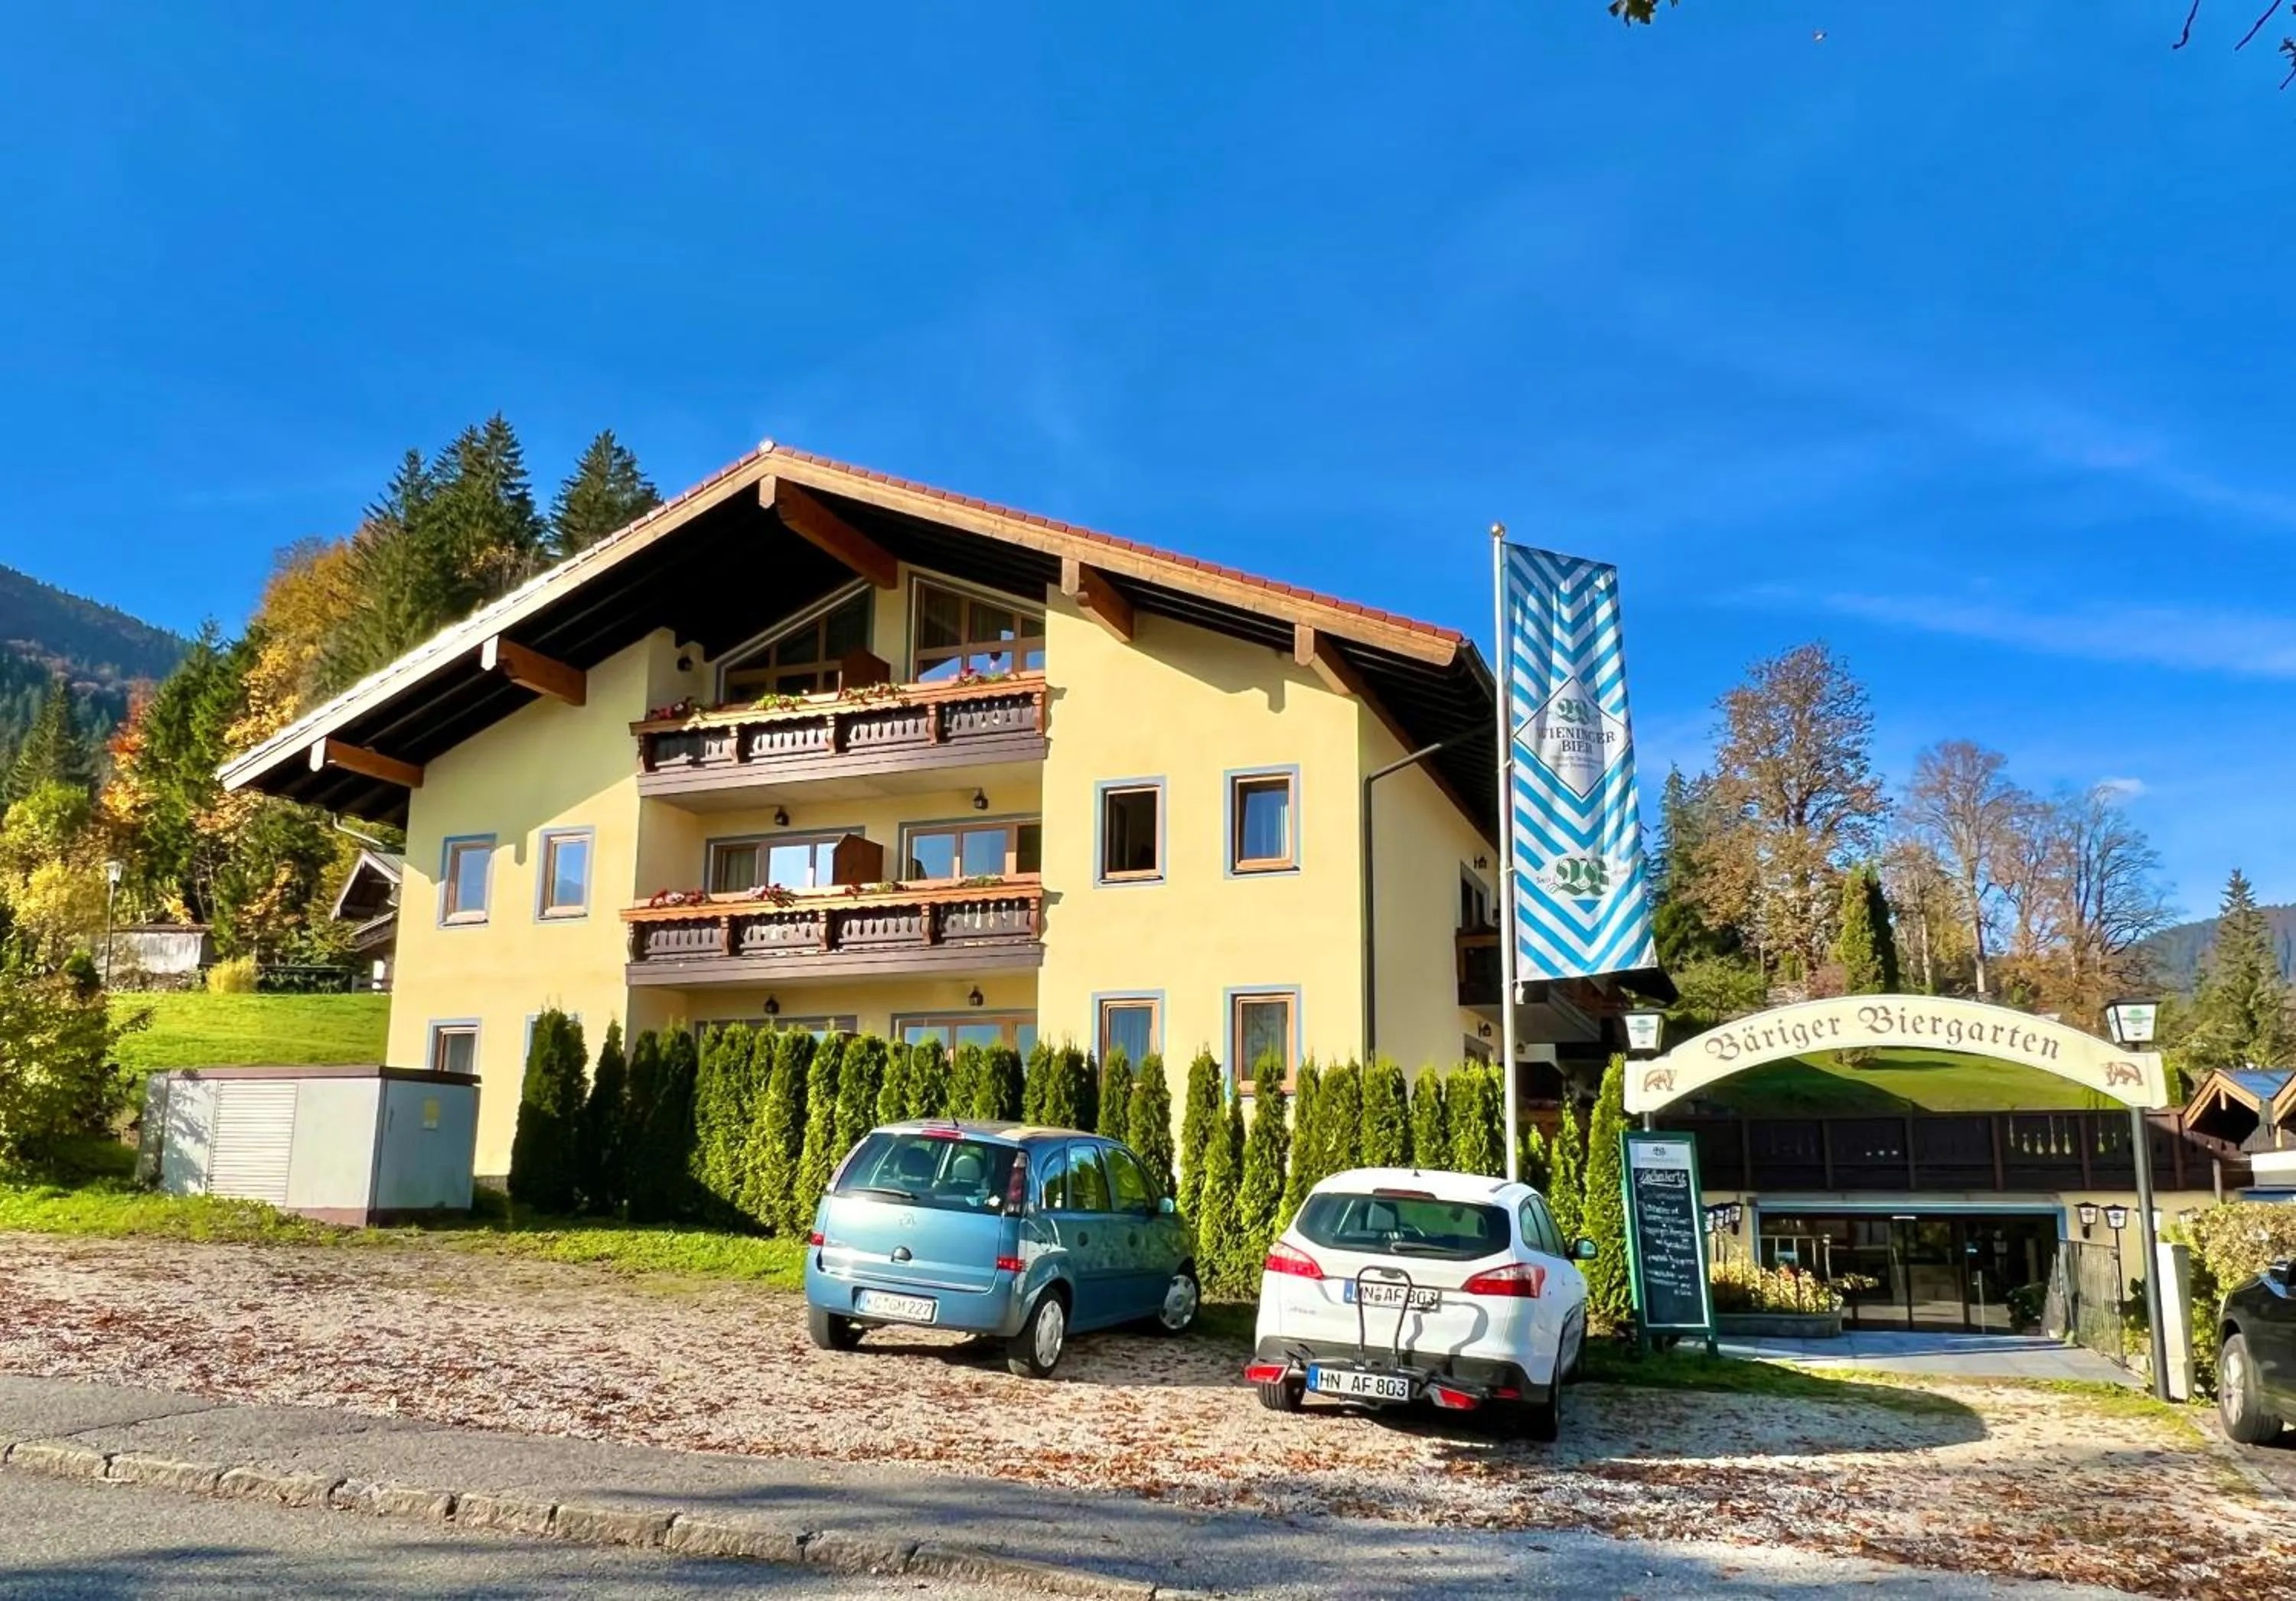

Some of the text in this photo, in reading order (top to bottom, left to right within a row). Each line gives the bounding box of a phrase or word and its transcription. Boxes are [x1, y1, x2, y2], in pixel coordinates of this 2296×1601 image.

[1561, 740, 1593, 754] BIER
[1704, 1005, 2060, 1061] Bäriger Biergarten
[1383, 1287, 1404, 1302] AF
[1408, 1290, 1437, 1306] 803
[908, 1300, 931, 1316] 227
[1319, 1370, 1407, 1397] HN AF 803
